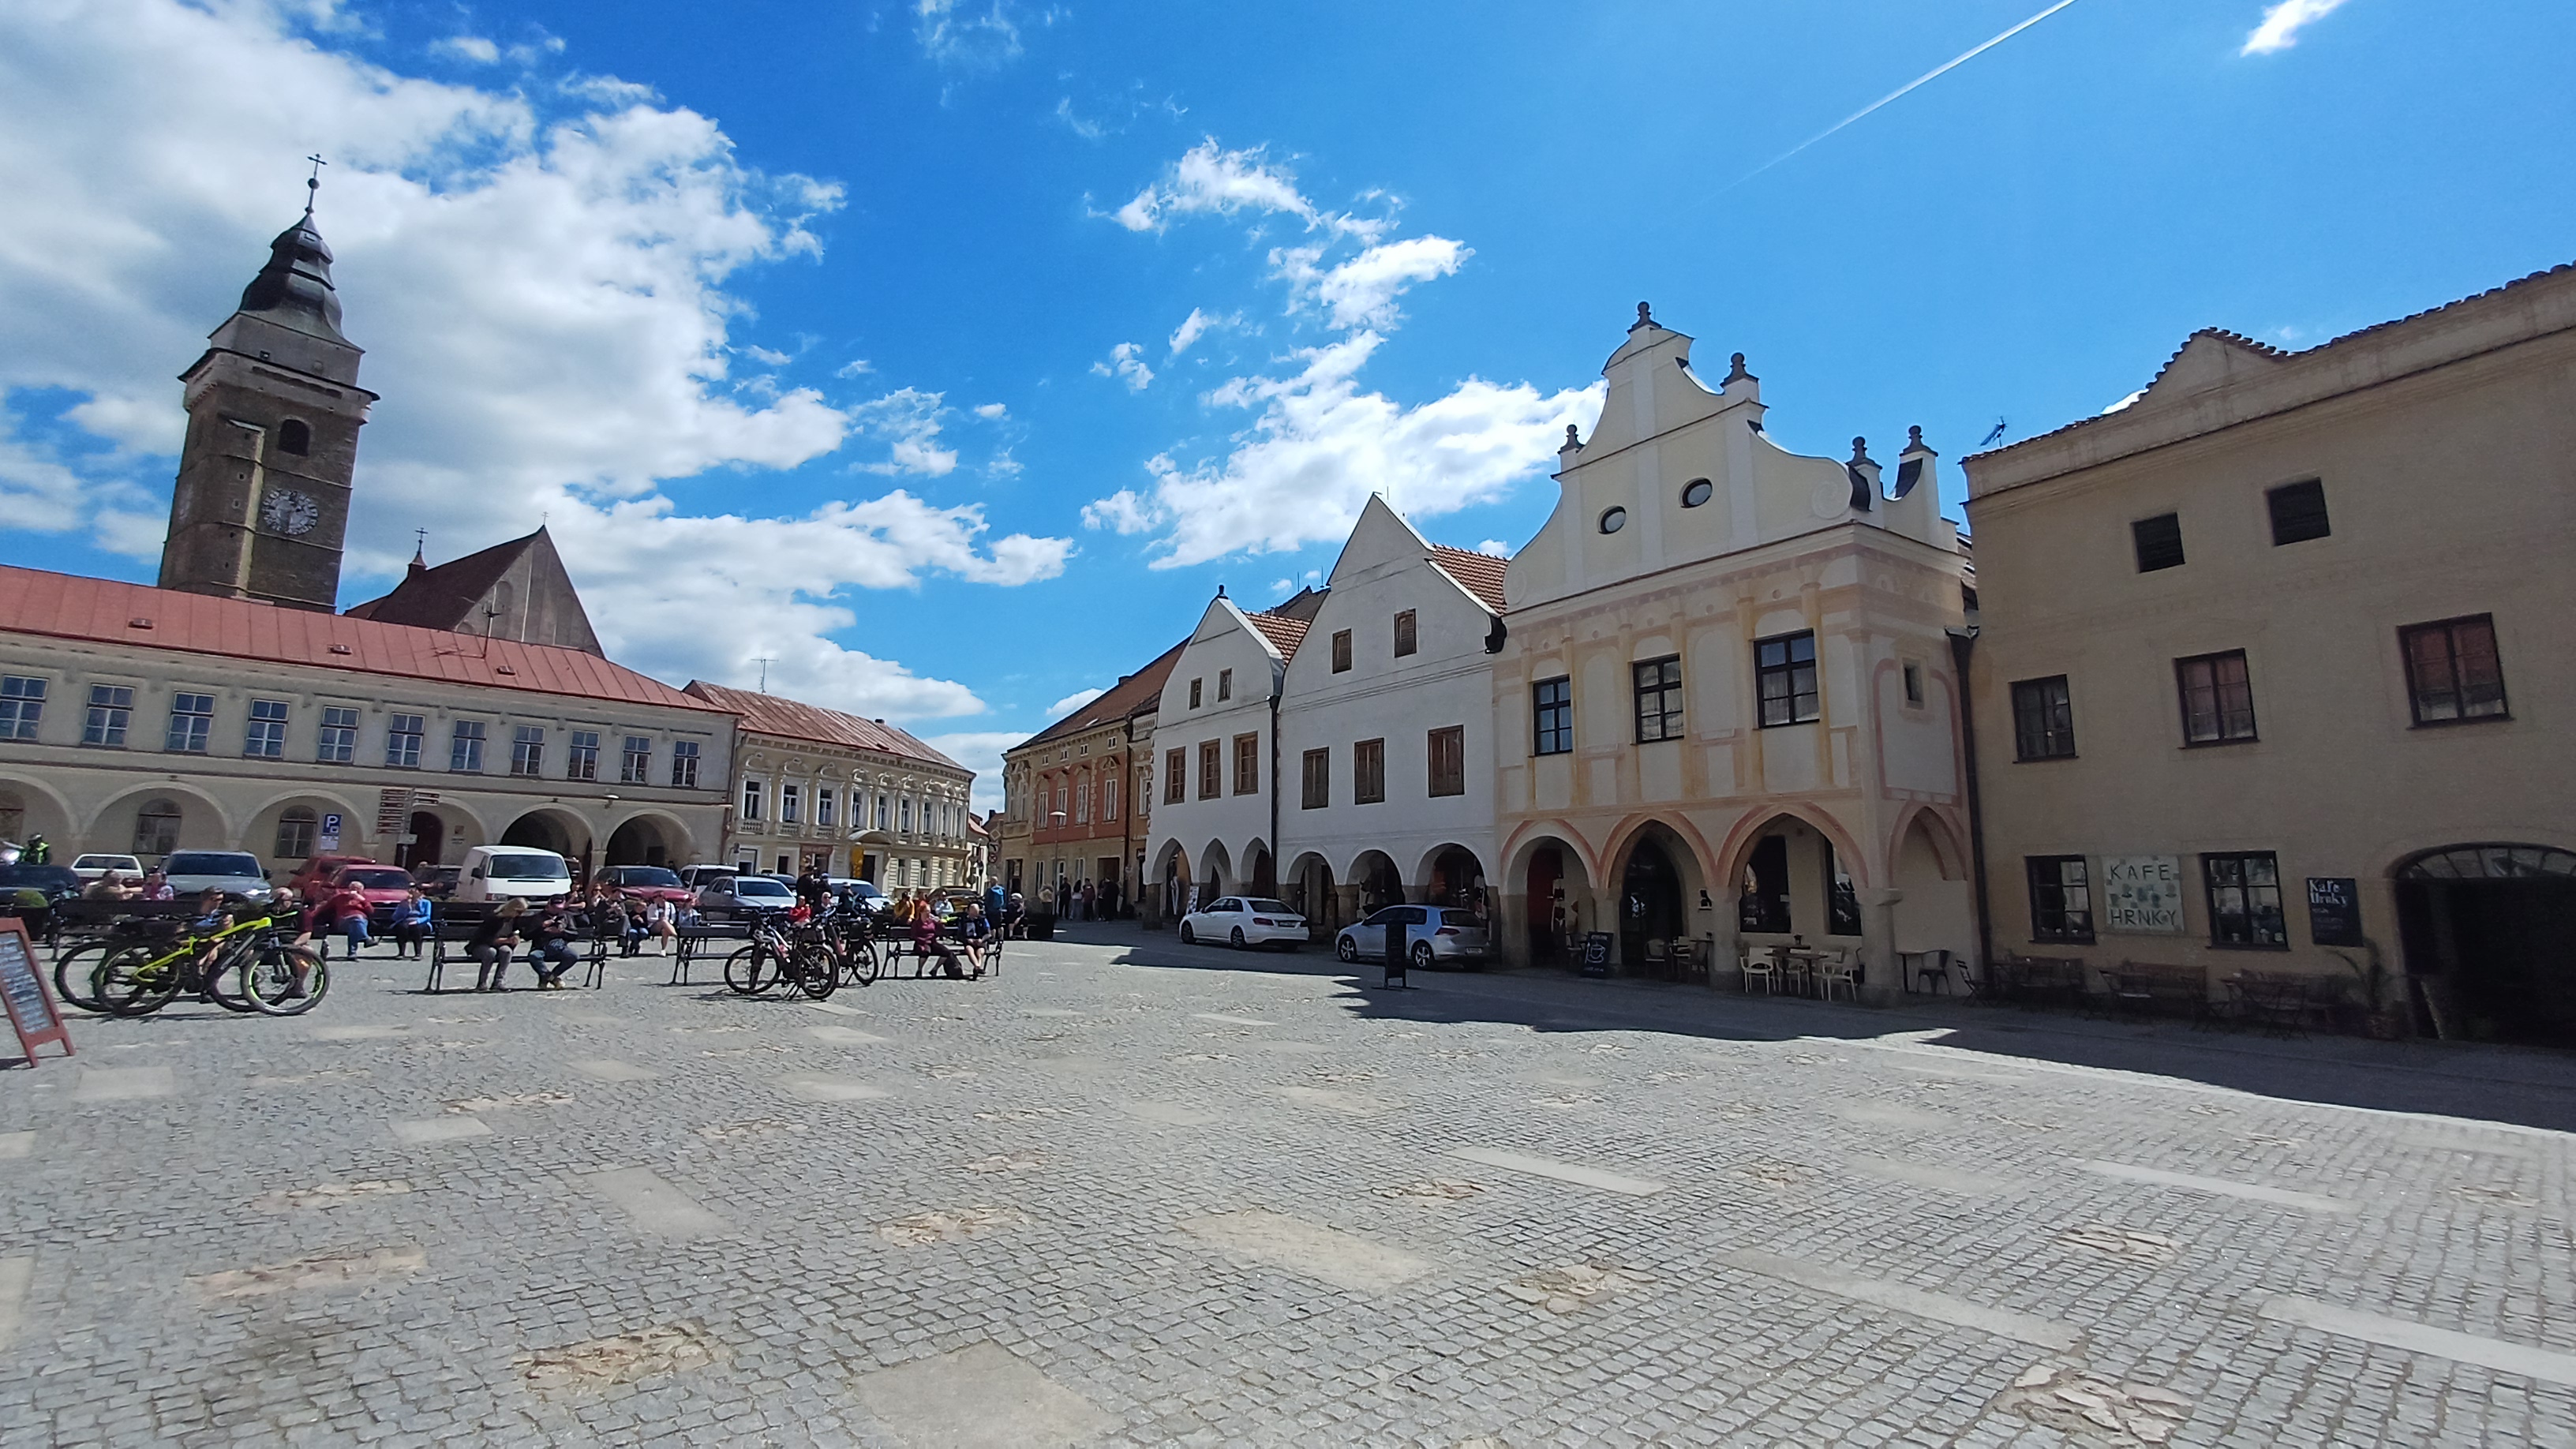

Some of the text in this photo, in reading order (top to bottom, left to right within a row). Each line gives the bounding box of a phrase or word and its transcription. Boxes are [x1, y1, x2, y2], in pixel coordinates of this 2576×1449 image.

[326, 815, 339, 828] P
[2110, 864, 2171, 881] KAFE
[2309, 879, 2340, 893] Kafe
[2110, 908, 2177, 926] HRNKY
